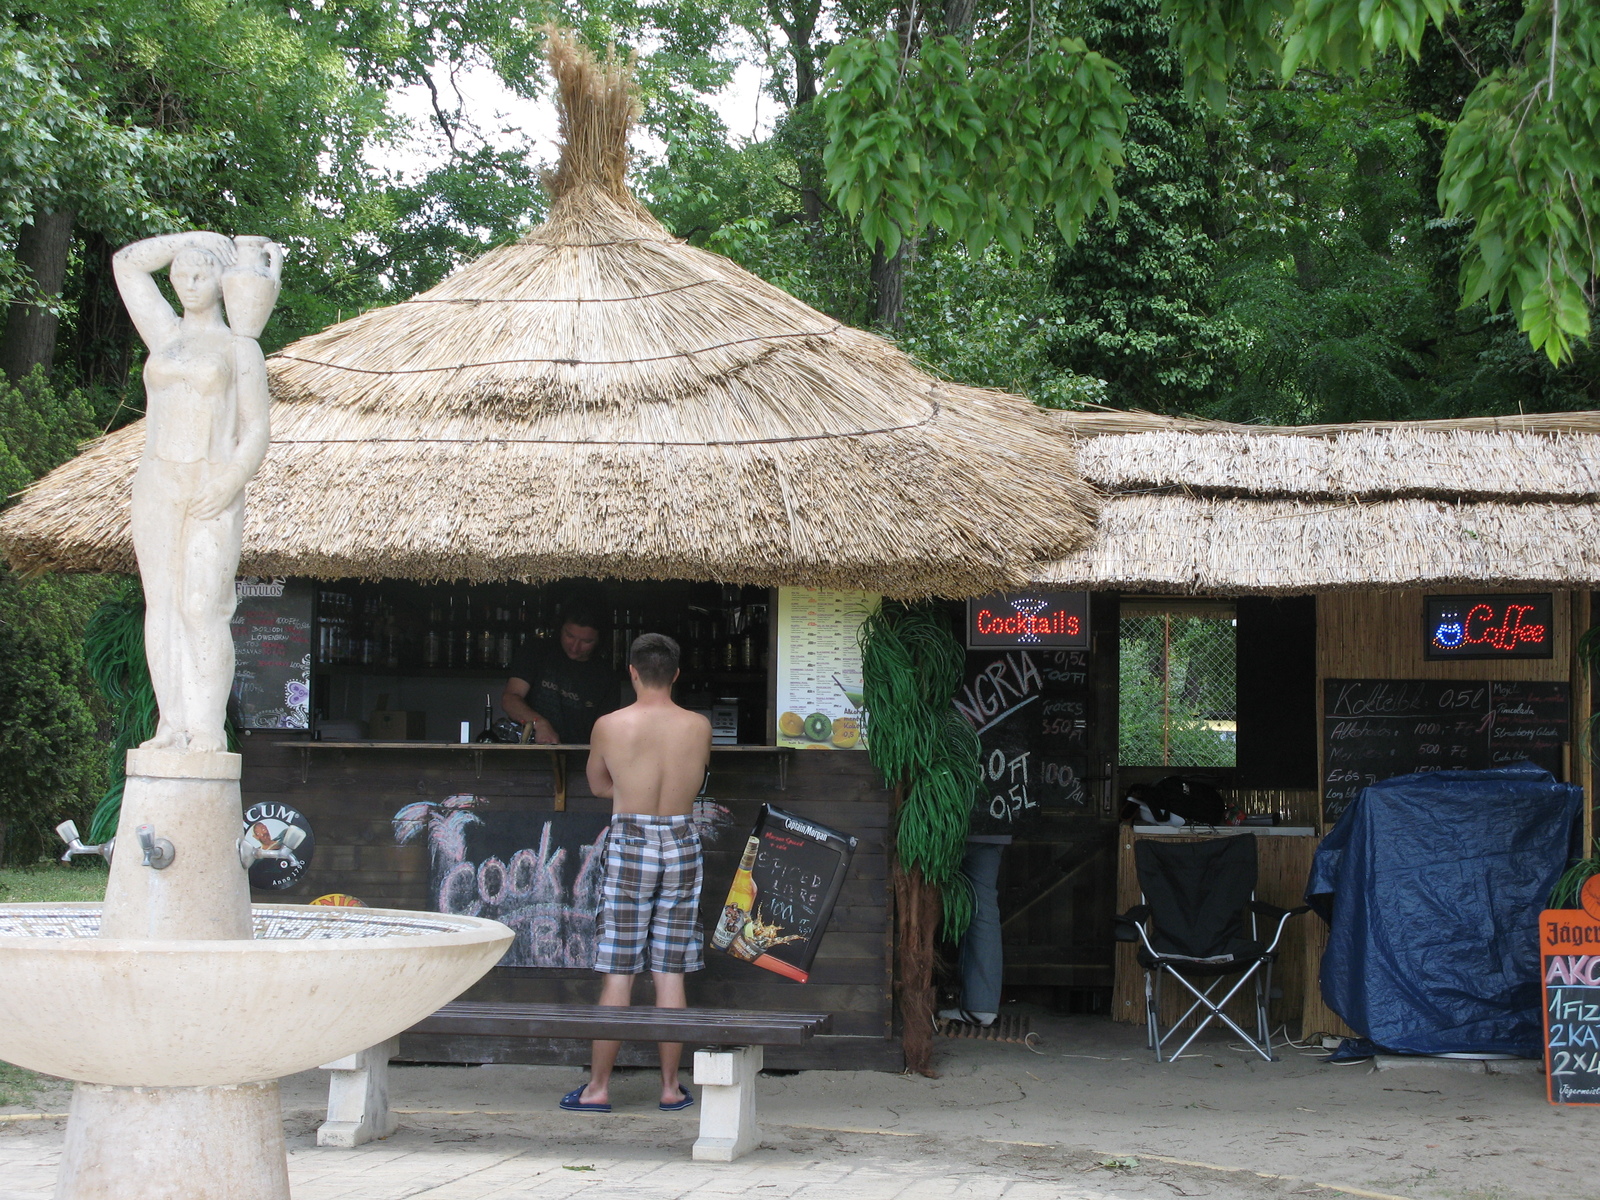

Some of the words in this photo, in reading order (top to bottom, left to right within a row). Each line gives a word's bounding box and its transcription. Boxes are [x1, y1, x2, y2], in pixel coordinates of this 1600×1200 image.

[978, 610, 1079, 635] Cocktails
[1465, 604, 1546, 650] Coffee
[952, 651, 1043, 728] NGRIA
[243, 805, 296, 830] CUM
[784, 818, 806, 834] Captain
[804, 826, 828, 843] Morgan
[272, 875, 292, 886] Anno
[291, 859, 306, 877] 1790
